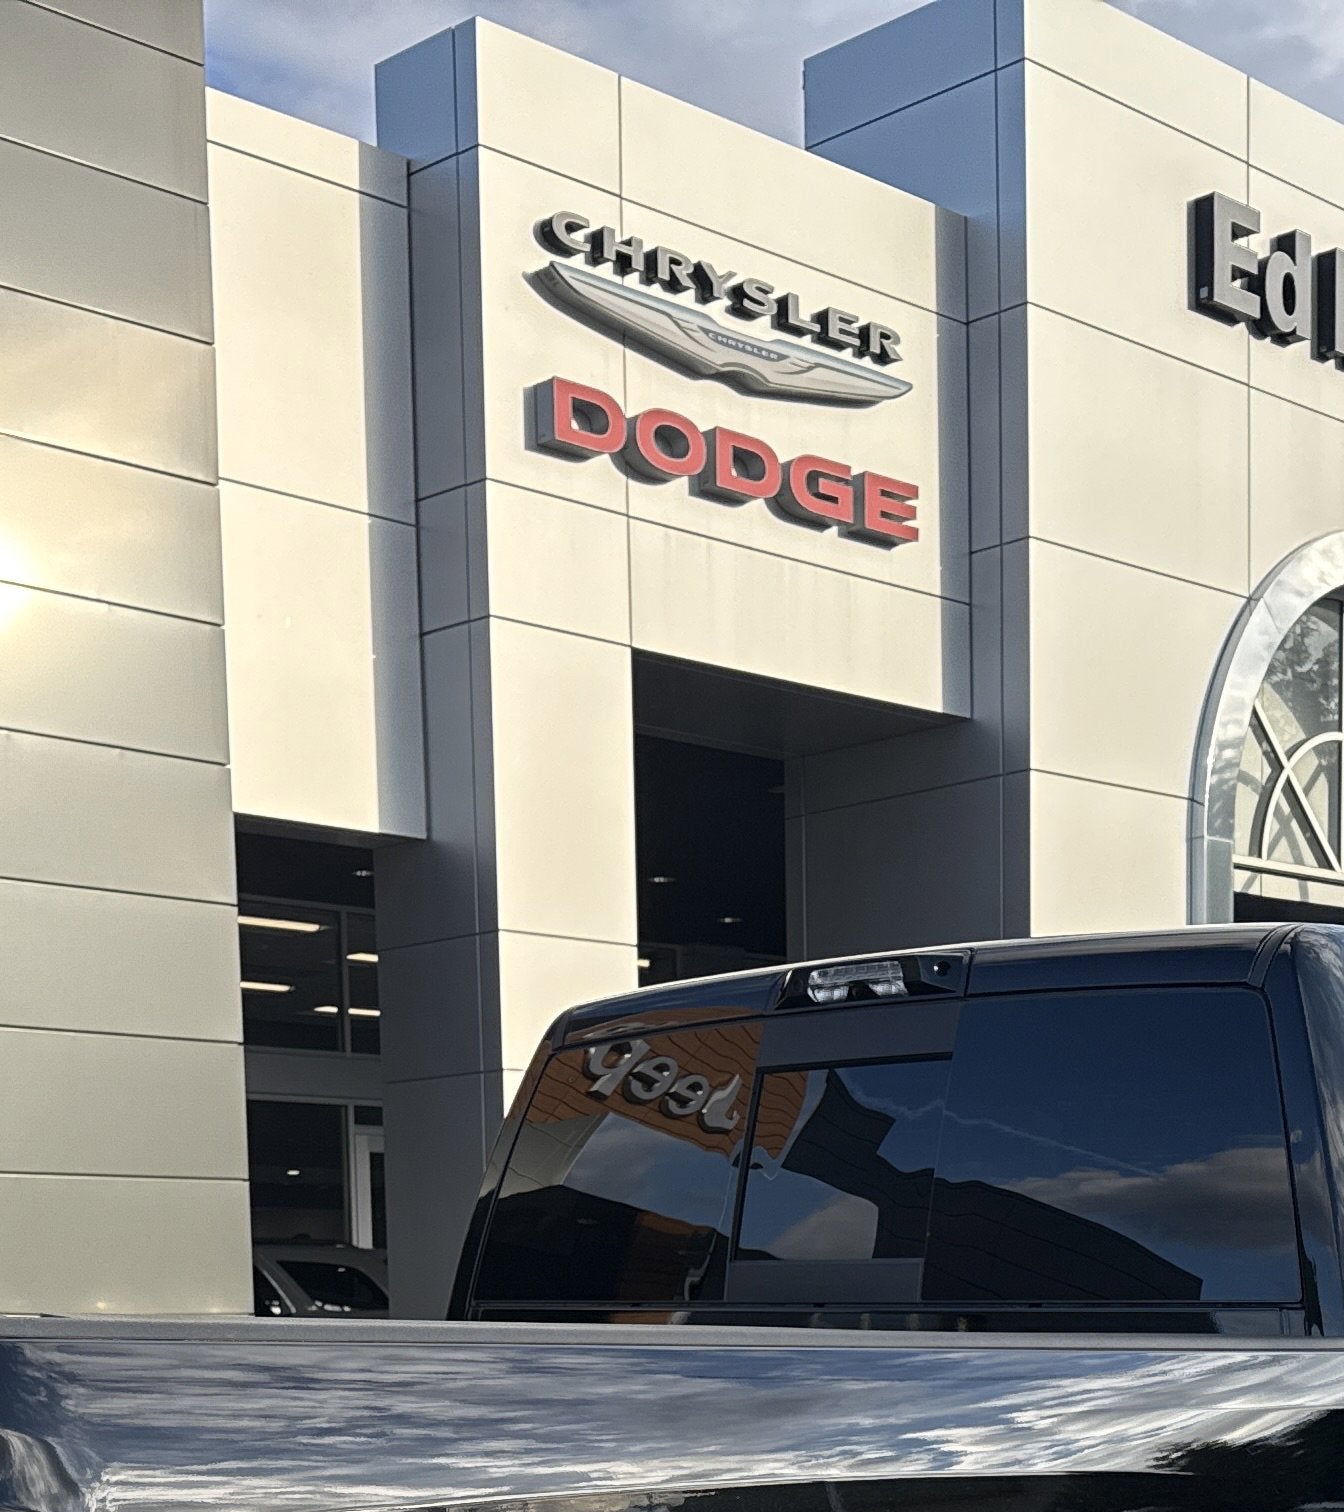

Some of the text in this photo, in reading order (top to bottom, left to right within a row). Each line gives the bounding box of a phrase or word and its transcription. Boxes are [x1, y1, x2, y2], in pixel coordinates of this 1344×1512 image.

[536, 210, 903, 365] CHRYSLER
[1188, 191, 1311, 346] Ed
[528, 376, 919, 549] DODGE
